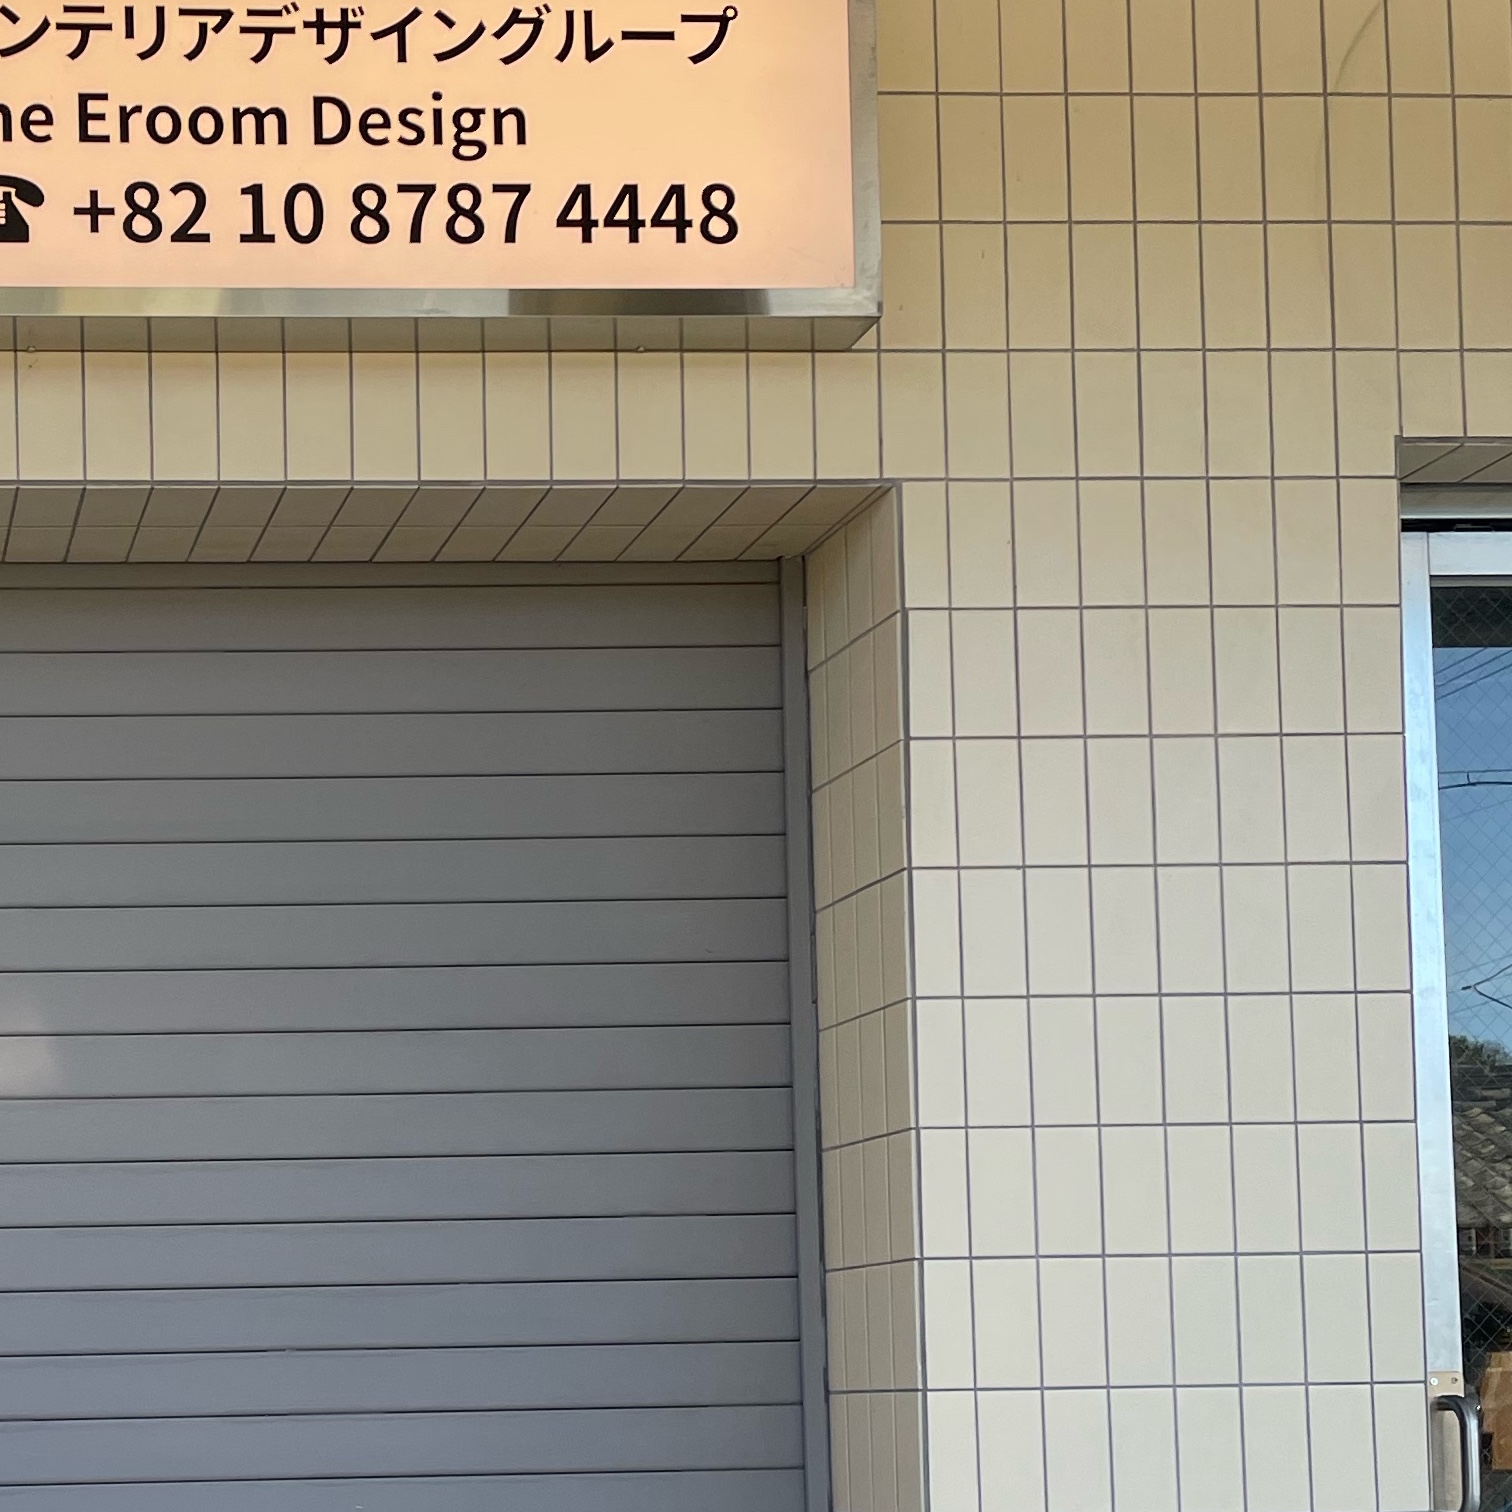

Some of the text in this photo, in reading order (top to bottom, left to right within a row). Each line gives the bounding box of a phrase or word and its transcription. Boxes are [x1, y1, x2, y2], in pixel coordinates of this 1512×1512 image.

[77, 92, 289, 145] Eroom
[312, 91, 528, 161] Design
[73, 181, 739, 245] +82 10 8787 4448
